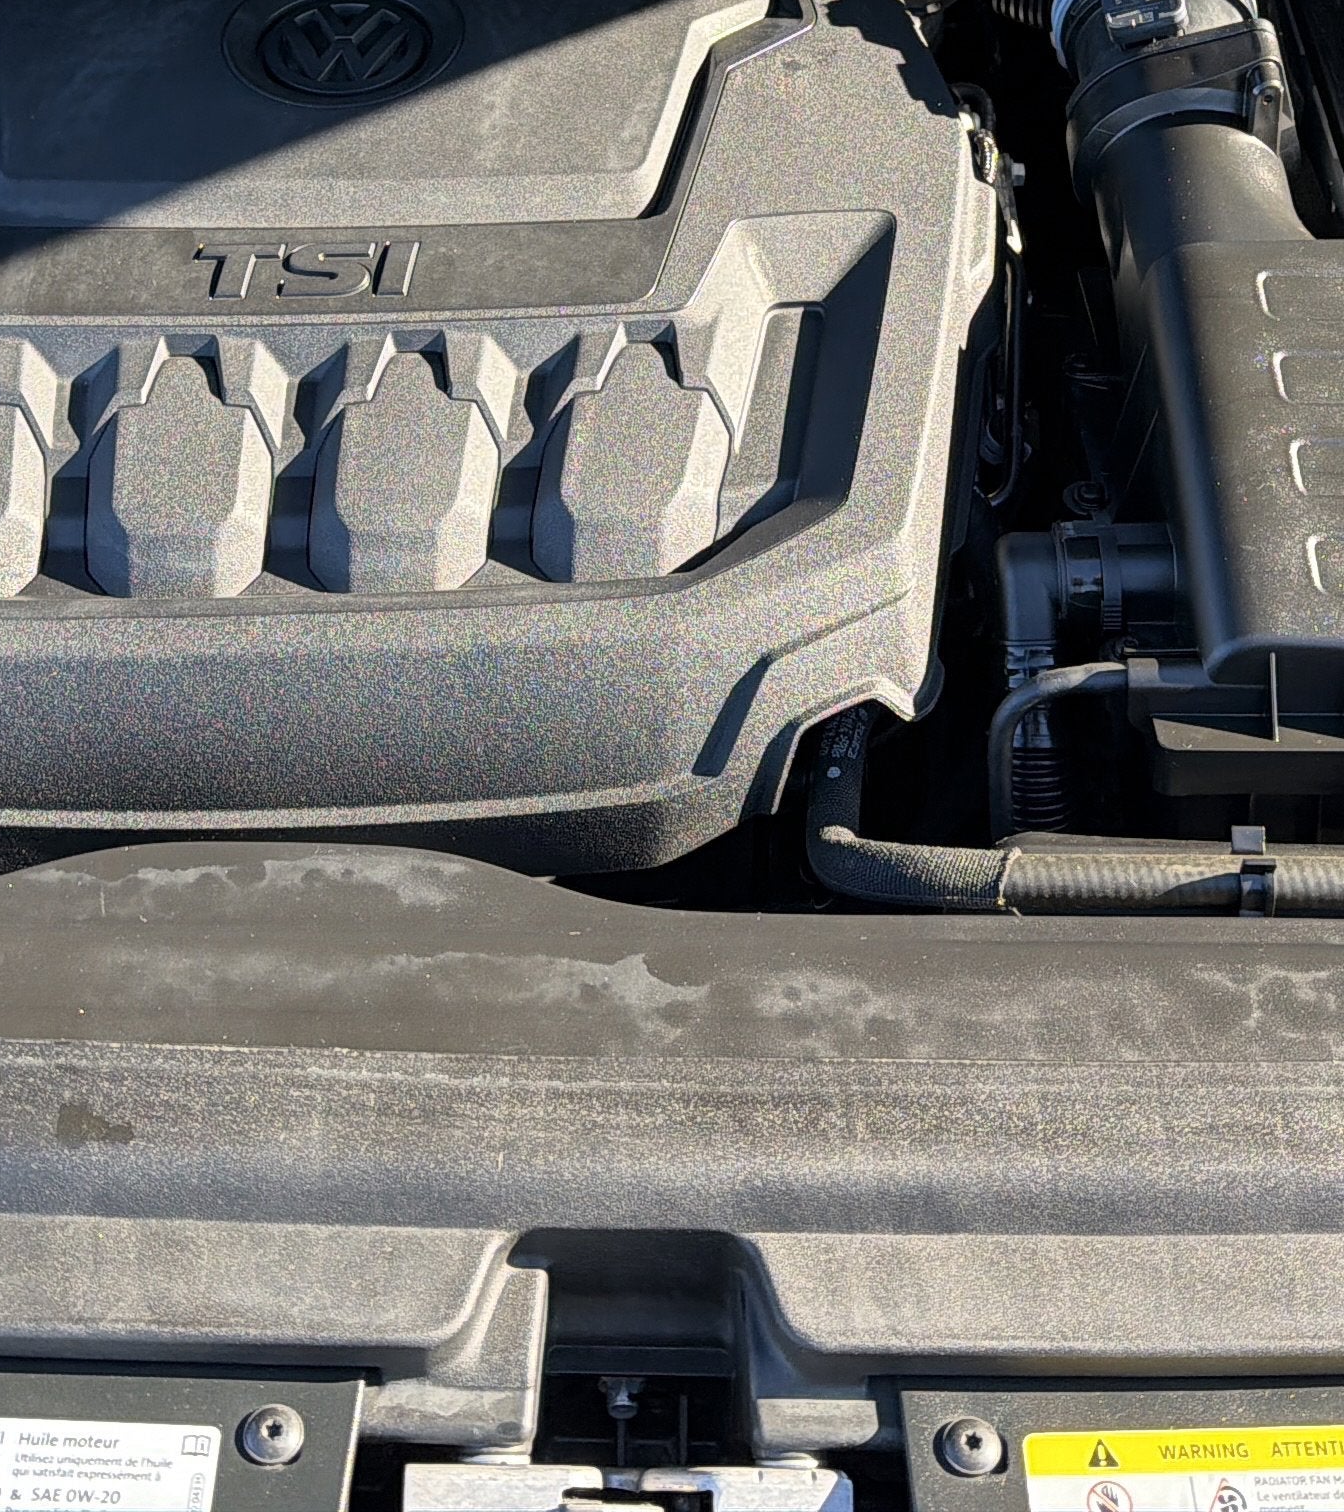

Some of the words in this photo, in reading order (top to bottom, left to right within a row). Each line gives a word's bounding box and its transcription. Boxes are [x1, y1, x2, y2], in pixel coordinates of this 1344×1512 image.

[192, 242, 421, 300] TSI
[18, 1432, 59, 1447] Huile
[62, 1436, 120, 1449] moteur
[1158, 1442, 1249, 1460] WARNING
[57, 1456, 122, 1467] uniquement
[125, 1457, 139, 1468] de
[12, 1468, 30, 1478] qui
[1254, 1475, 1307, 1486] RADIATOR
[1309, 1475, 1331, 1485] FAN
[10, 1488, 22, 1500] &
[30, 1487, 62, 1502] SAE
[65, 1489, 122, 1505] 0W-20
[1257, 1491, 1269, 1501] Le
[1272, 1489, 1331, 1501] ventilateur
